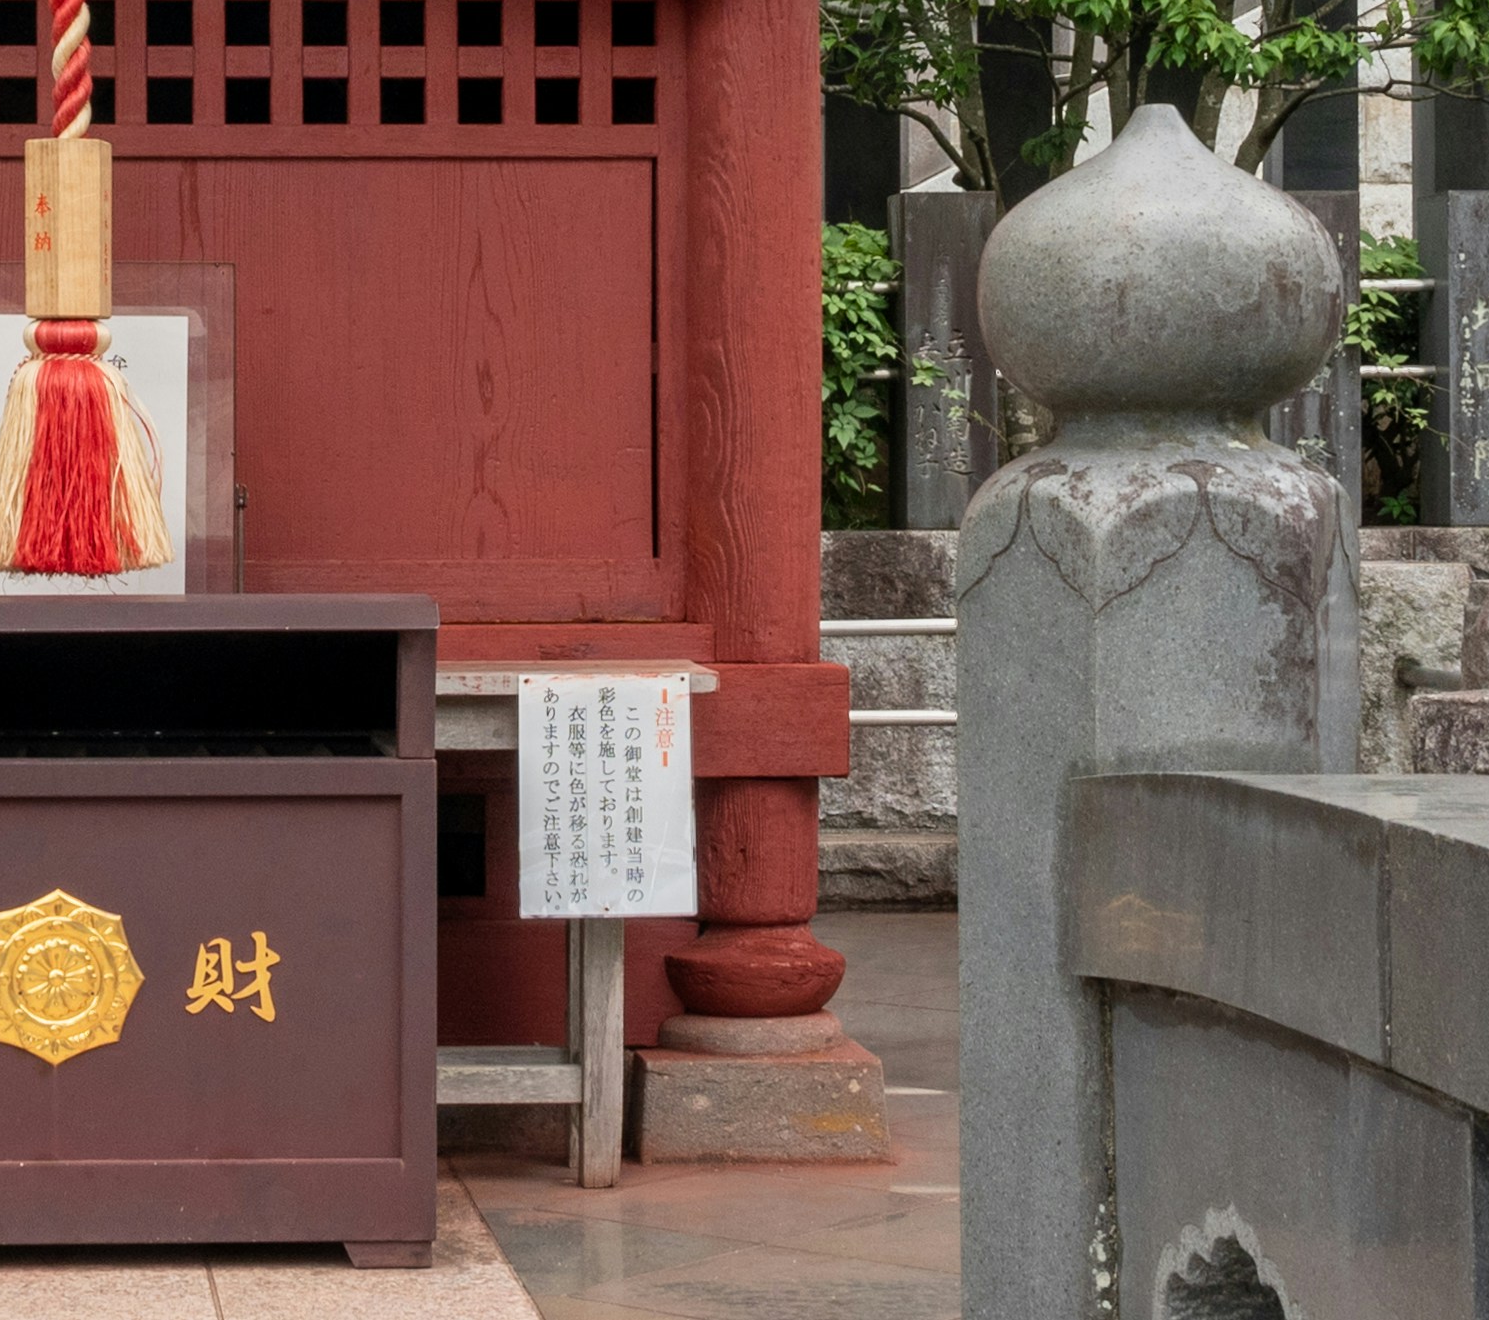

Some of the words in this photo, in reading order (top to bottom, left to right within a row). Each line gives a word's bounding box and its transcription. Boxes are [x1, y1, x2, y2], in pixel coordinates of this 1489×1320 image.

[34, 192, 52, 251] 奉納
[543, 687, 562, 912] ありますのでご注意下さい。
[568, 705, 588, 904] 衣服等に色が移る恐れが
[598, 687, 618, 876] 彩色を施しております。
[624, 707, 645, 903] この御堂は創建当時の
